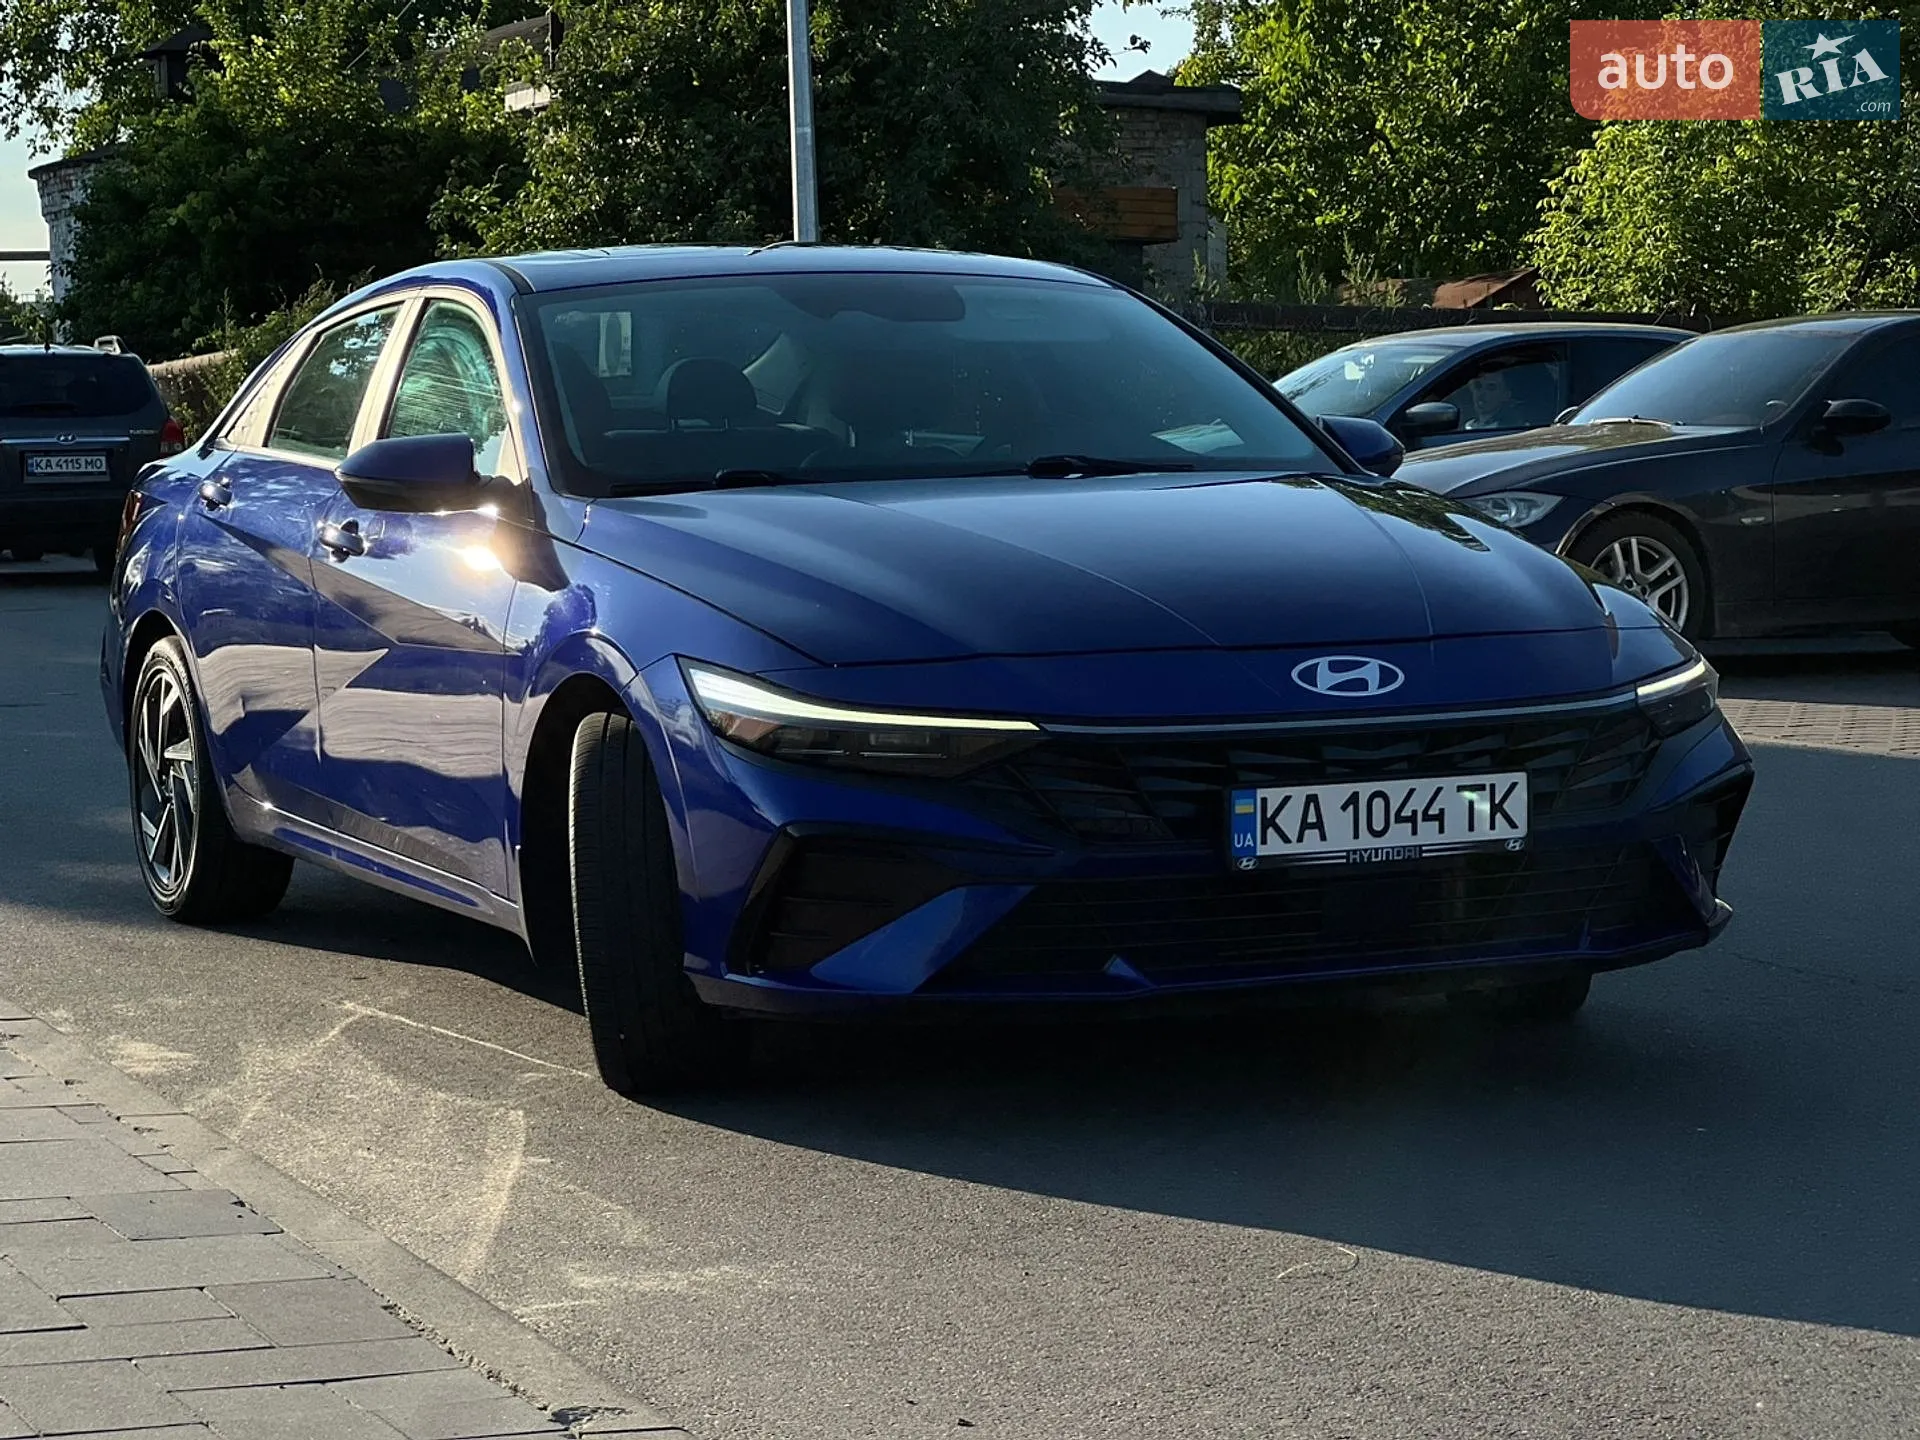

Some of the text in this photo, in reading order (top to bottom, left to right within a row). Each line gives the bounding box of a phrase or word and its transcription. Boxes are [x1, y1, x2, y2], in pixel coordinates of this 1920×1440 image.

[34, 458, 103, 471] KA 4115 MO
[1259, 781, 1520, 846] KA 1044 TK
[1233, 833, 1254, 849] UA
[1349, 846, 1420, 864] HYUNDAI
